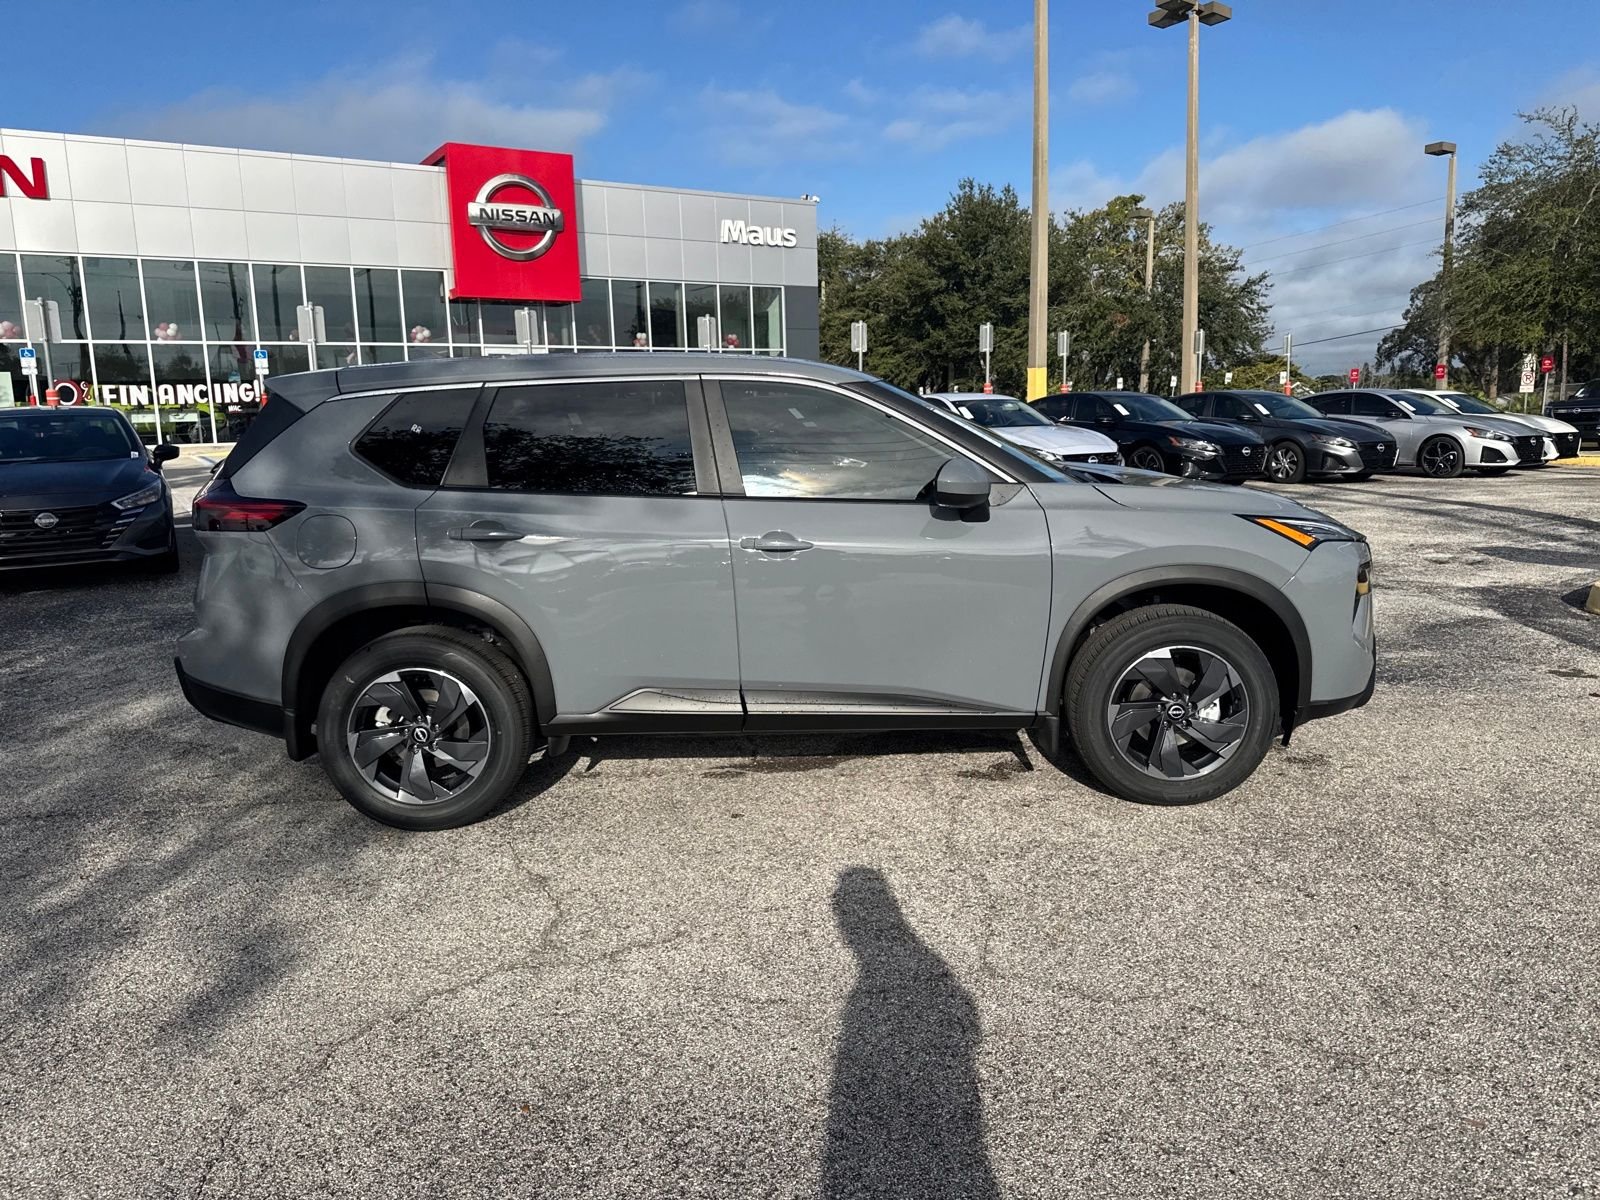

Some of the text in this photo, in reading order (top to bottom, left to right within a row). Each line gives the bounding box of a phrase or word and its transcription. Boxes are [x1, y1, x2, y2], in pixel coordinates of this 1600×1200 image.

[479, 207, 556, 225] NISSAN
[720, 219, 797, 248] Maus
[102, 379, 260, 406] FINANCING!
